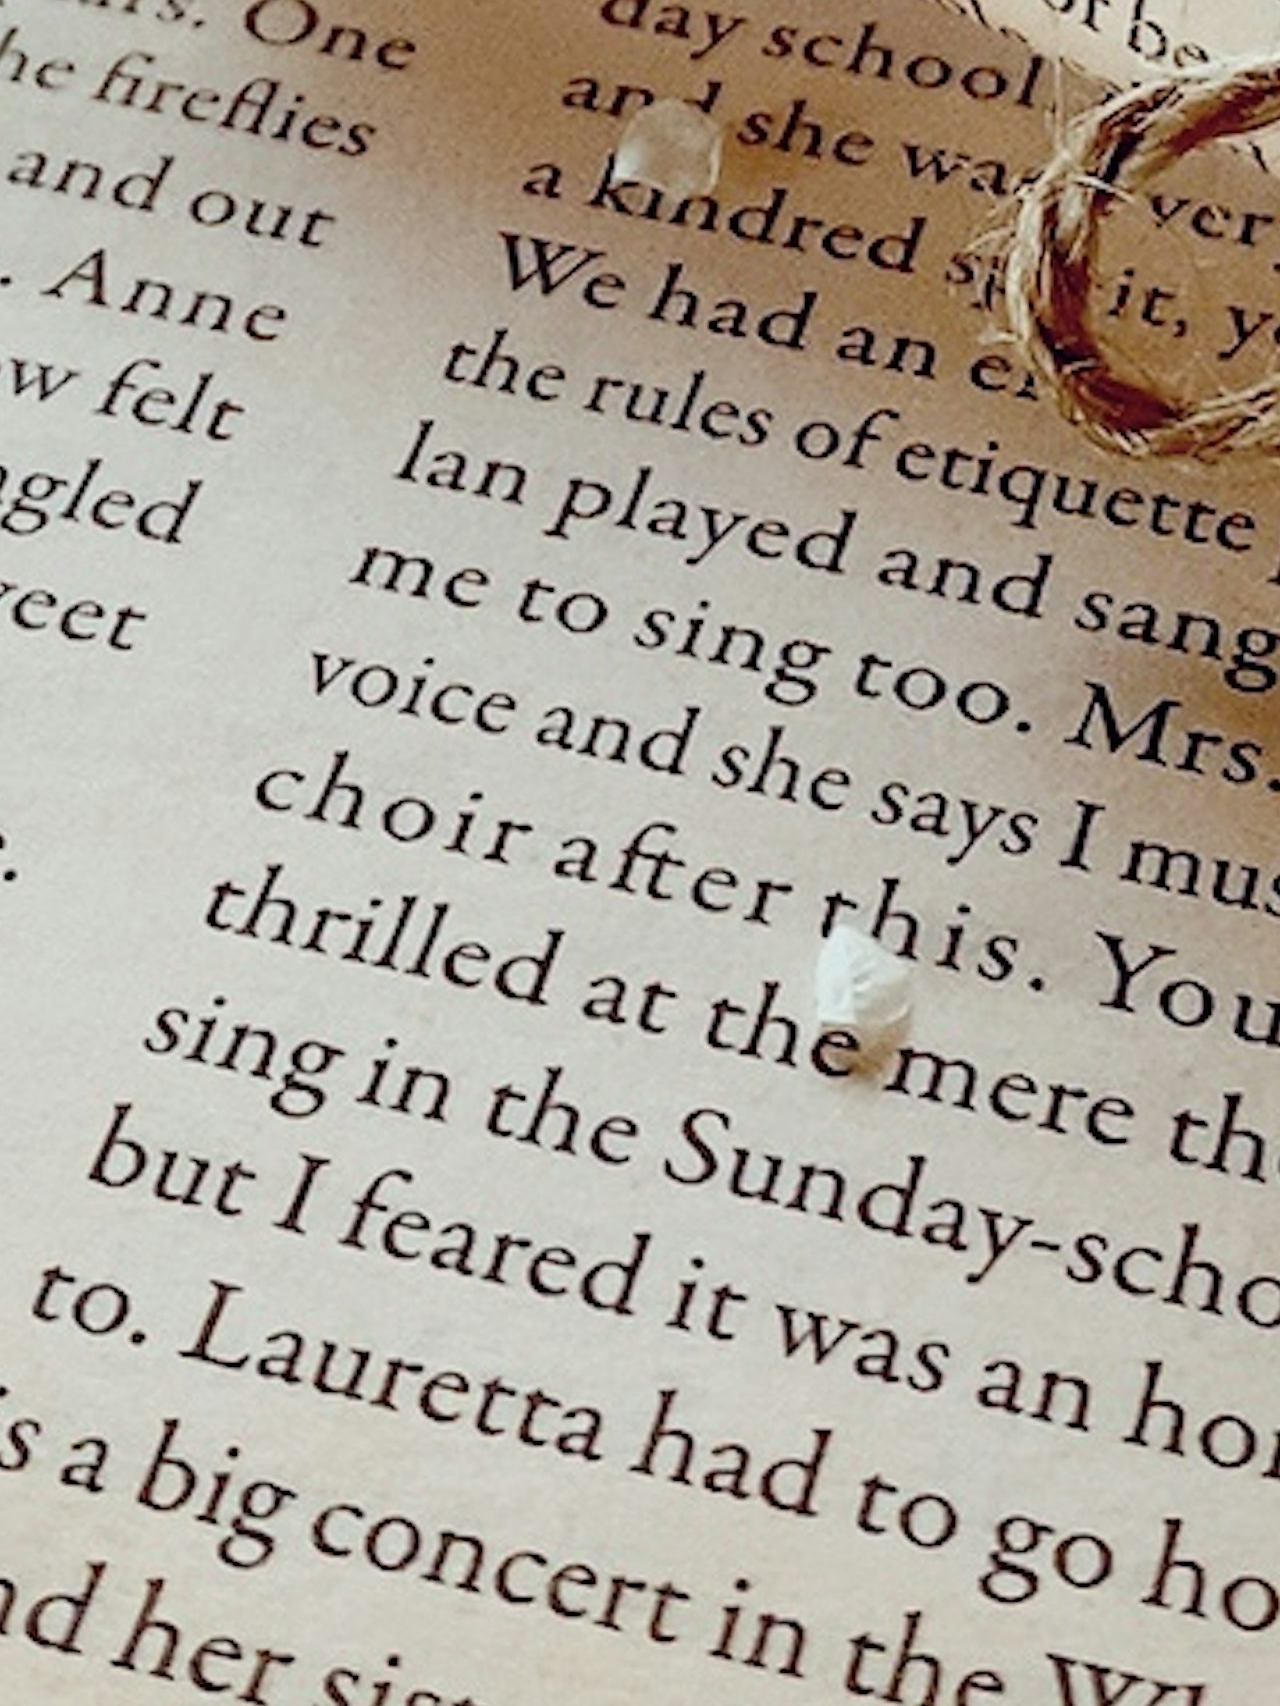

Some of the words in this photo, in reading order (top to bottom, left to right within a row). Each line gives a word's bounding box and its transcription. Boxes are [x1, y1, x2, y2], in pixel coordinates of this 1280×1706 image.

[761, 21, 1045, 110] school
[5, 151, 176, 214] and
[188, 190, 337, 249] out
[95, 359, 245, 442] felt
[443, 328, 567, 402] the
[584, 369, 774, 447] rules
[794, 408, 901, 470] of
[895, 440, 1256, 553] etiquette
[311, 652, 518, 735] voice
[535, 705, 702, 776] and
[710, 725, 852, 812] she
[870, 781, 1039, 867] says
[1058, 799, 1106, 873] I
[143, 996, 346, 1119] sing
[355, 1037, 451, 1123] in
[485, 1065, 639, 1166] the
[31, 1265, 147, 1346] to.
[178, 1279, 603, 1462] Lauretta
[628, 1388, 834, 1518] had
[856, 1474, 960, 1550] to
[978, 1515, 1115, 1605] go
